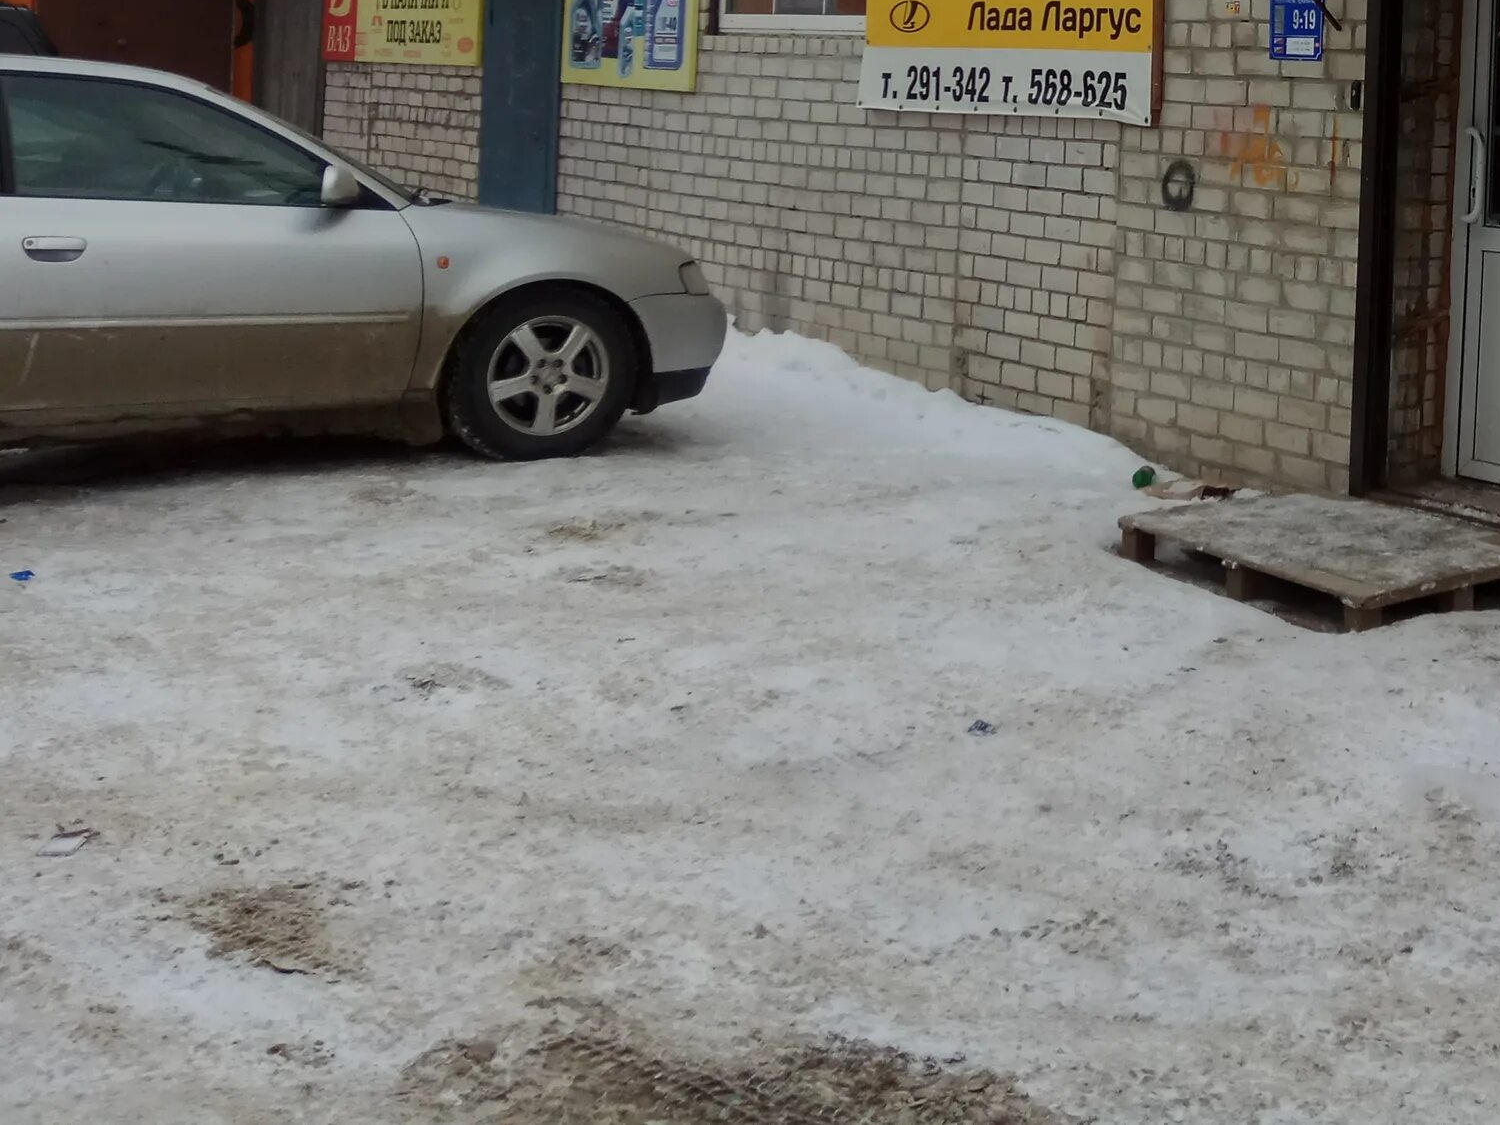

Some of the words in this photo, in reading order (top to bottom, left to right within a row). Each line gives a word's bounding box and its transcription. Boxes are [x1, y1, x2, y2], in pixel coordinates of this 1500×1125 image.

[386, 20, 407, 46] ПОД
[408, 20, 442, 43] ЗАКАЗ
[967, 1, 1032, 32] Лада
[1040, 1, 1142, 40] Ларгус
[327, 25, 351, 52] ВАЗ
[906, 65, 991, 103] 291-342
[1027, 68, 1128, 111] 568-625
